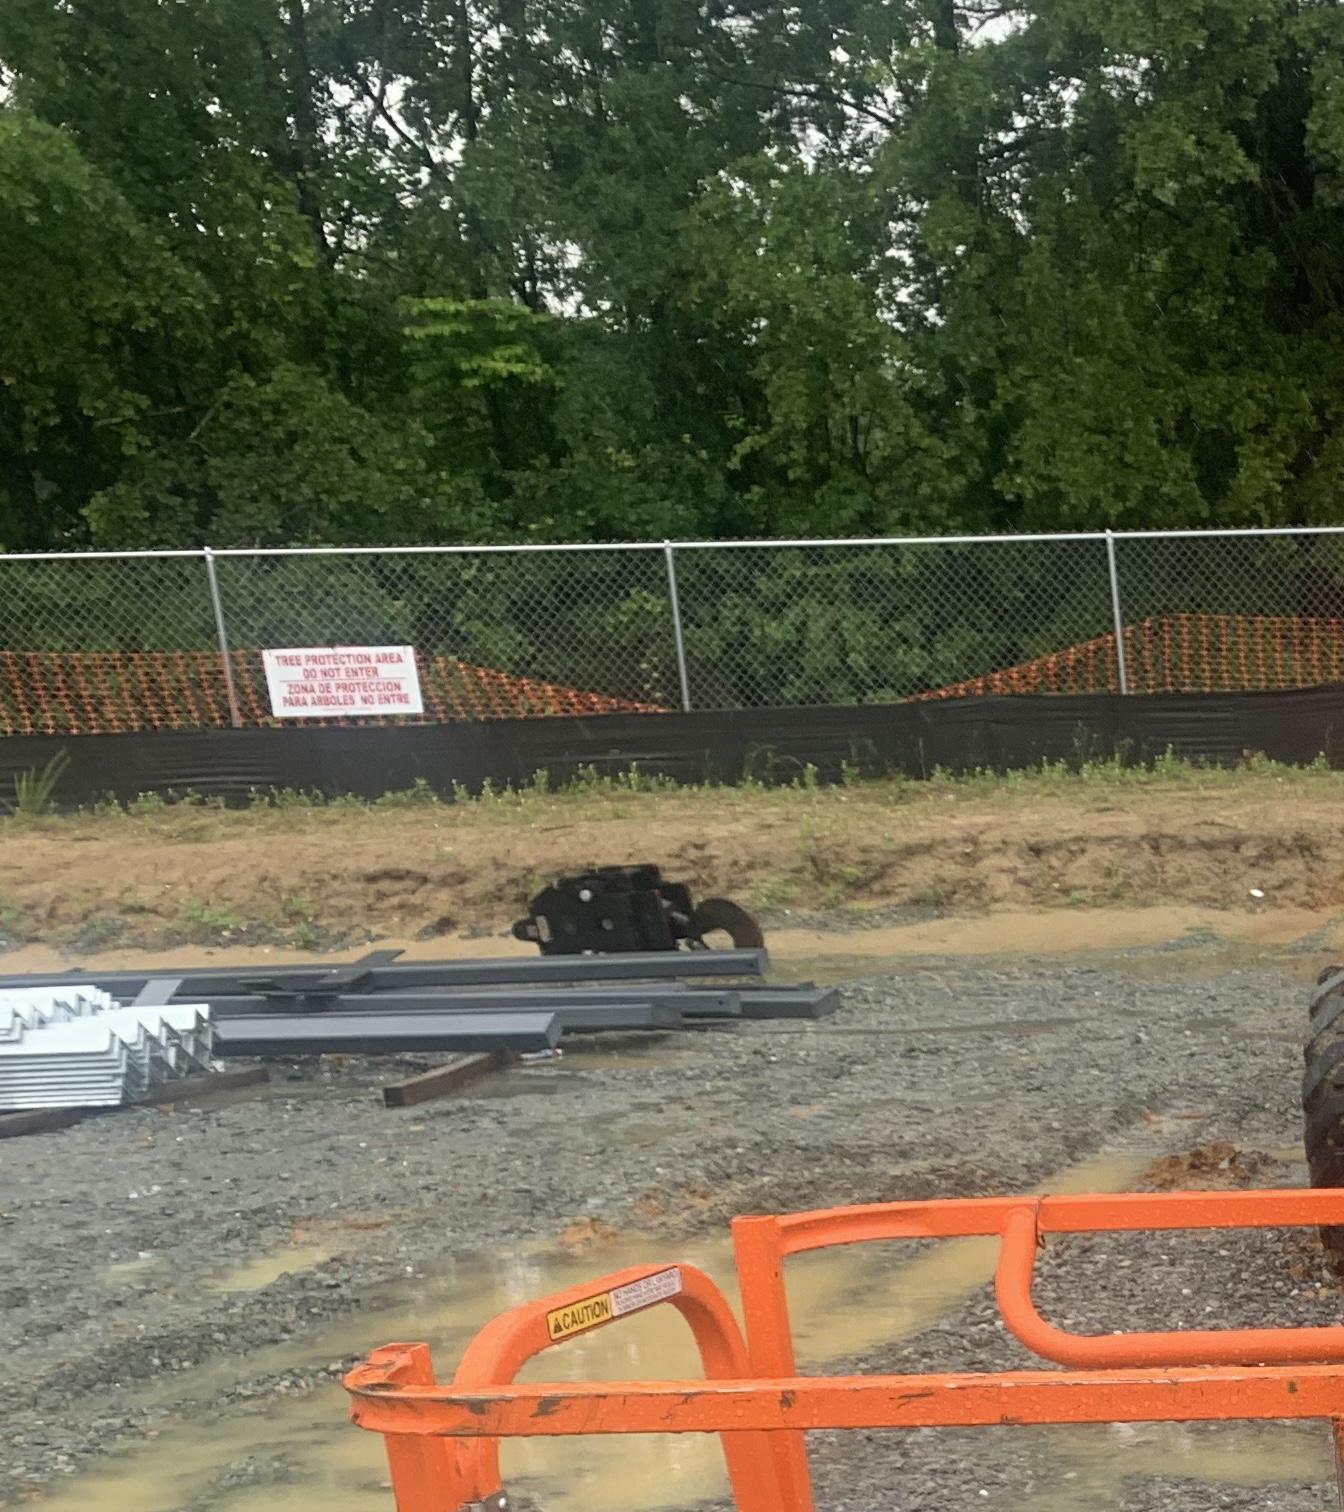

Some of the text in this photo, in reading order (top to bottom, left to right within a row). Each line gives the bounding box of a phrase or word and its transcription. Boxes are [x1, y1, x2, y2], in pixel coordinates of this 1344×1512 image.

[276, 652, 403, 666] TREE PROTECTION AREA
[303, 666, 379, 679] DO NOT ENTER
[288, 683, 315, 694] ZONA
[319, 683, 332, 693] DE
[282, 693, 410, 707] PARA ARBOLES NO ENTRE
[562, 1300, 609, 1329] CAUTION
